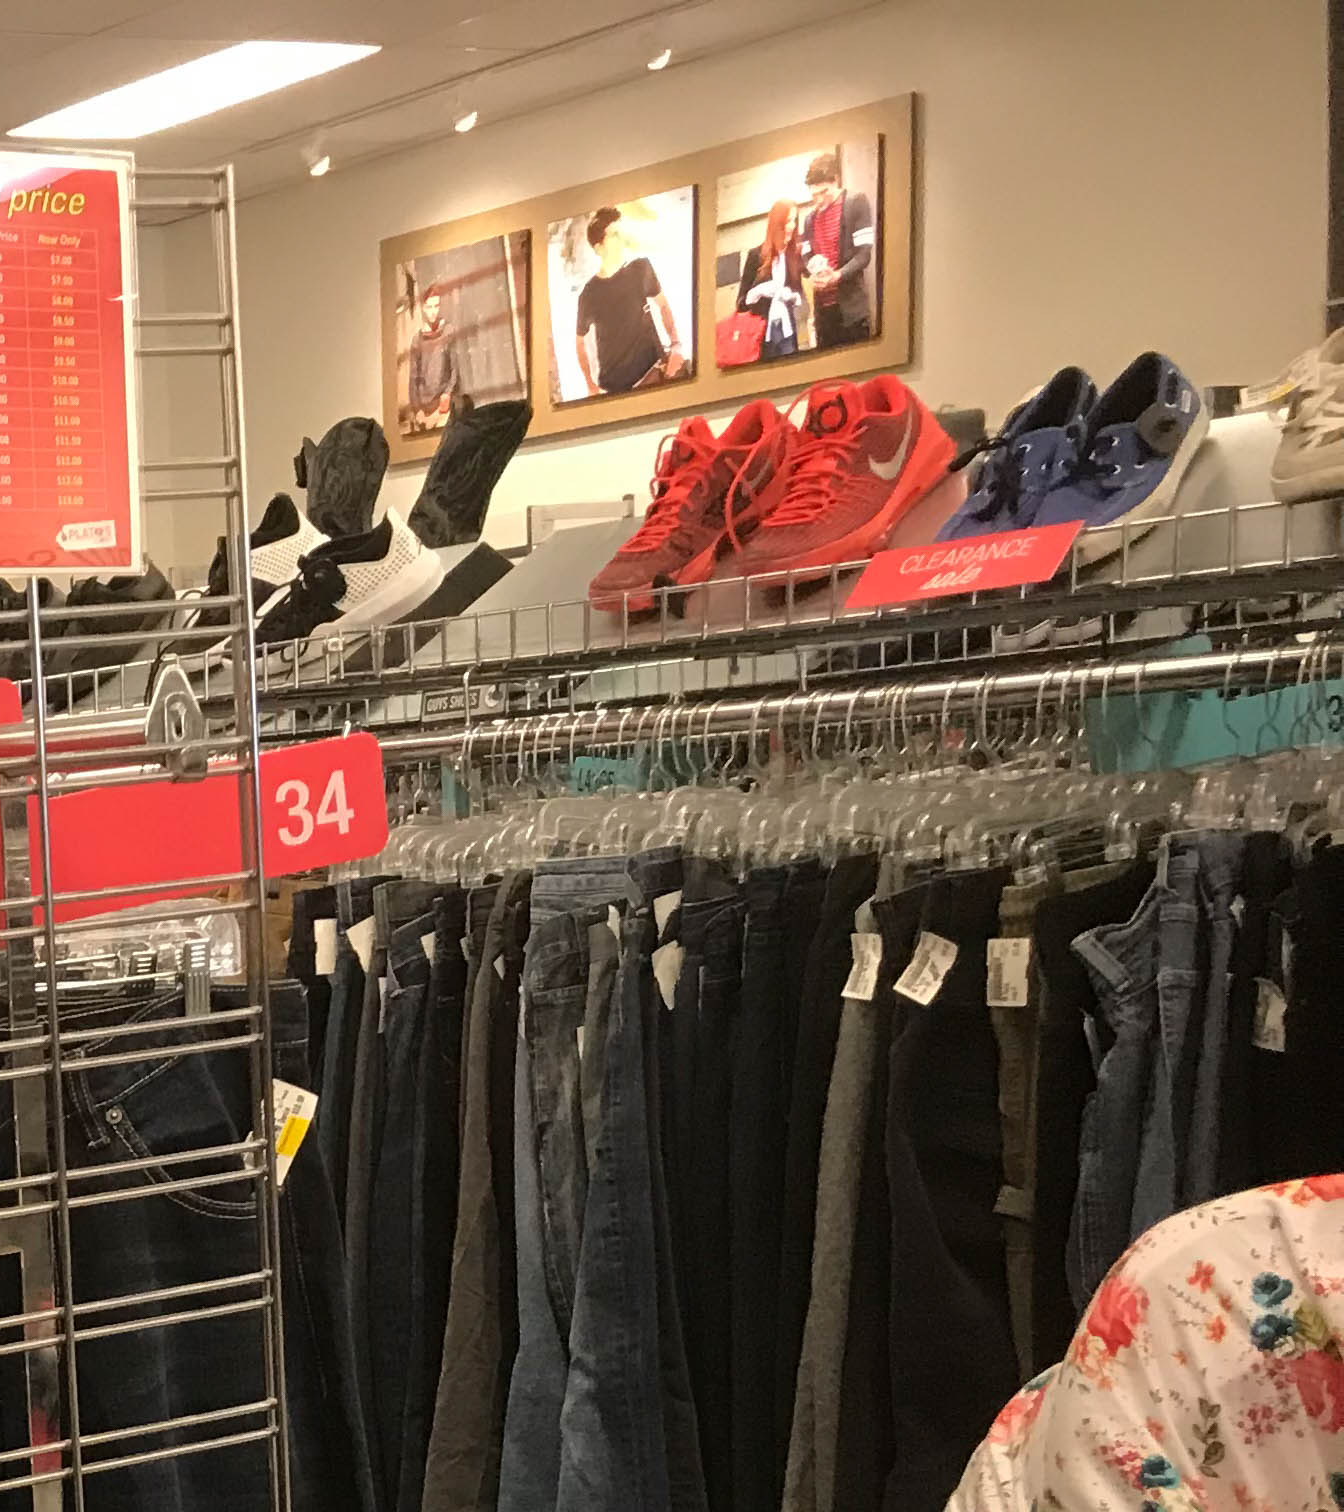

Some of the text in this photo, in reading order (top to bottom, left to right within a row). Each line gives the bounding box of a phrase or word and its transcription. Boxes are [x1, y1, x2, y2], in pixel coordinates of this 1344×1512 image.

[8, 184, 85, 220] price
[899, 535, 1038, 575] CLEARANCE
[919, 562, 983, 590] sale
[274, 769, 355, 847] 34
